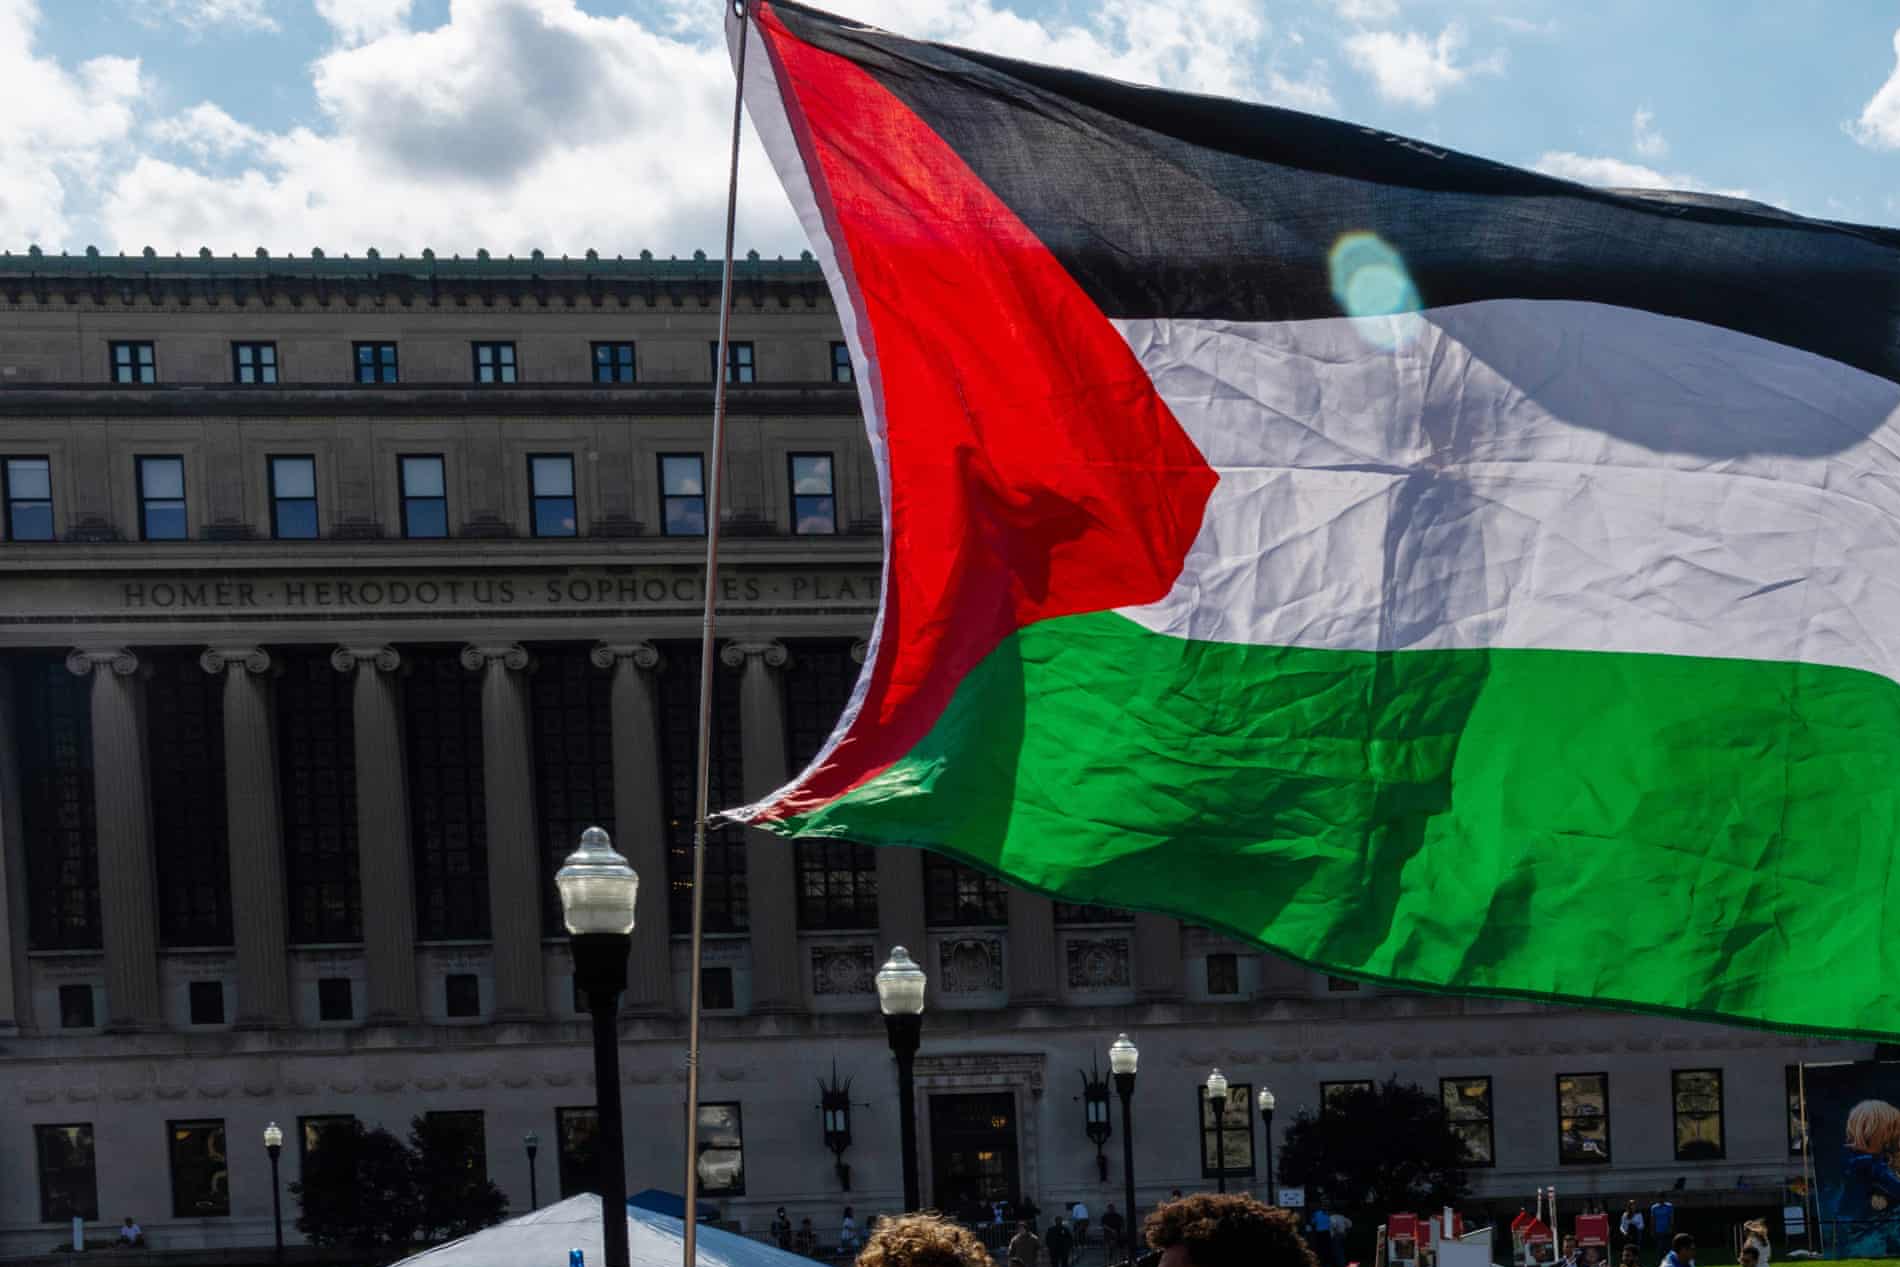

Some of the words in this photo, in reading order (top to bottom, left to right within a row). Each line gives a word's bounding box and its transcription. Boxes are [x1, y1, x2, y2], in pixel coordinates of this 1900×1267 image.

[124, 582, 256, 607] HOMER
[284, 580, 515, 606] HERODOTUS
[793, 576, 879, 601] PLAT
